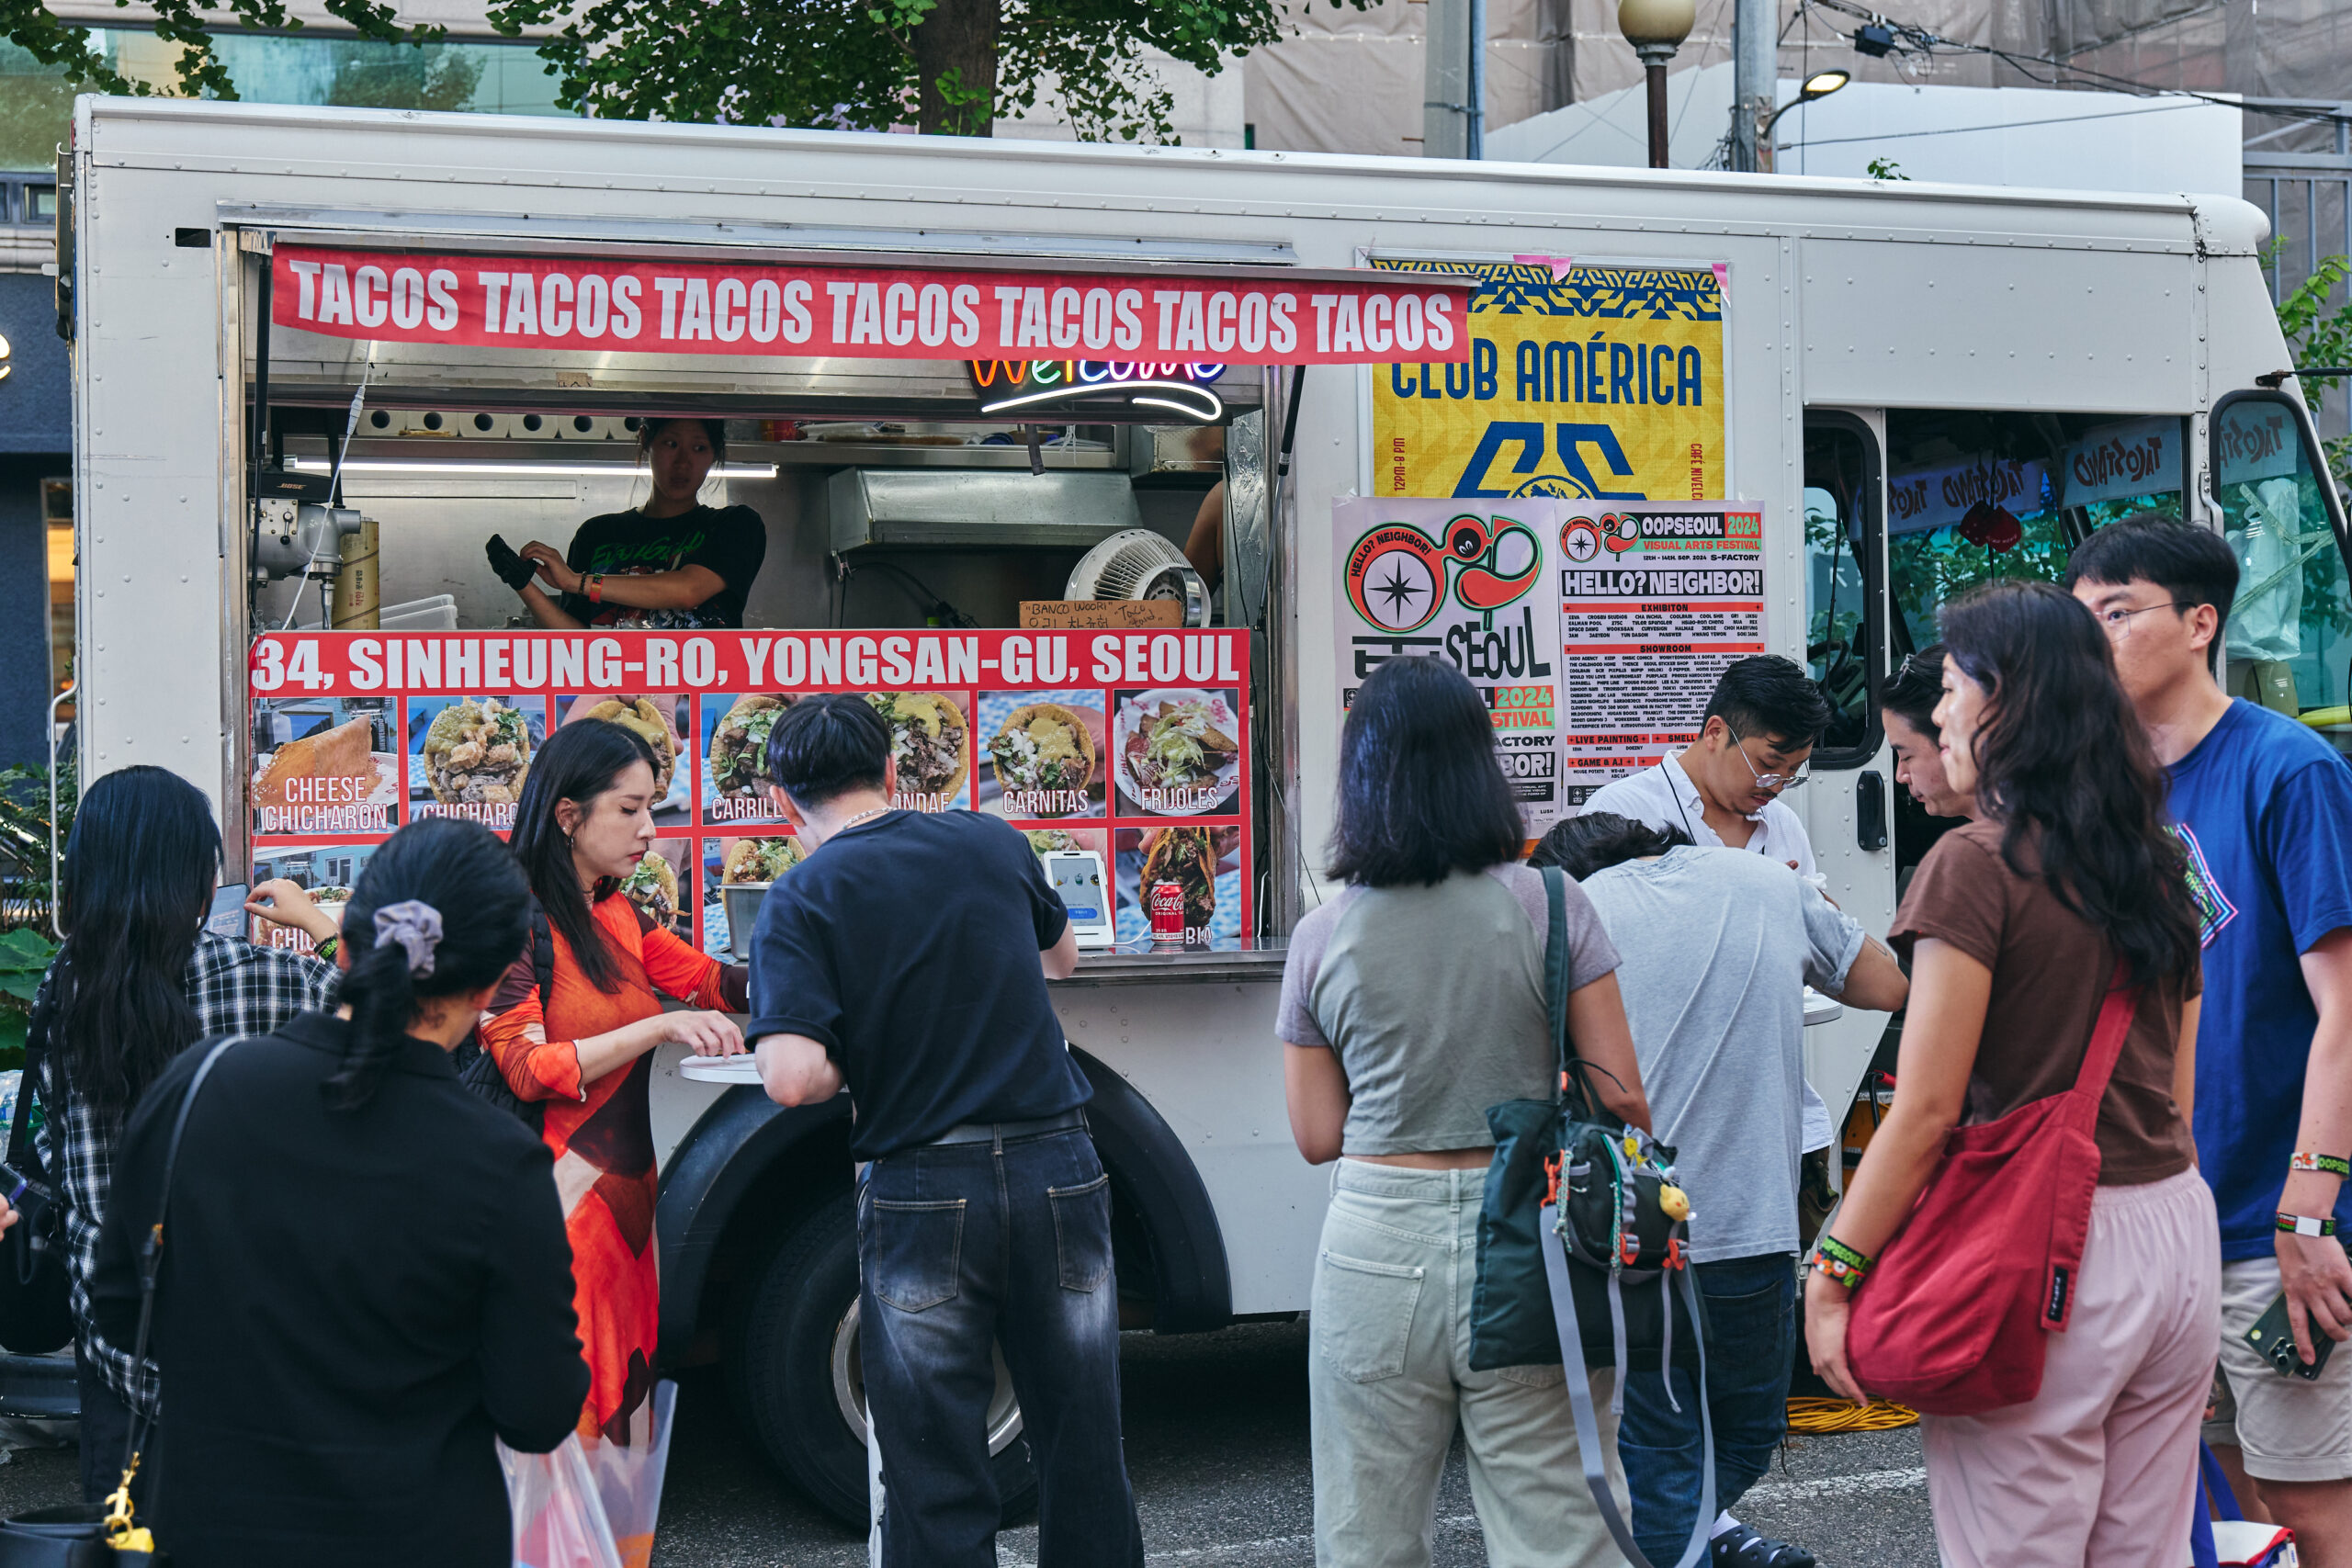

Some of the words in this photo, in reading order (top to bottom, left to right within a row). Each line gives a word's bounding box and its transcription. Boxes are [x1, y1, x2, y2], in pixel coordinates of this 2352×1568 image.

[288, 259, 459, 332] TACOS
[478, 271, 642, 339] TACOS
[654, 276, 813, 344] TACOS
[826, 281, 980, 348] TACOS
[994, 286, 1143, 351] TACOS
[1154, 289, 1297, 354] TACOS
[1311, 292, 1454, 353] TACOS
[1392, 338, 1498, 400] CLUB
[1517, 332, 1702, 406] AMÉRICA
[1393, 437, 1406, 454] PM
[1690, 443, 1705, 465] CAFÉ
[1690, 468, 1703, 501] NIVELC
[1642, 516, 1723, 536] OOPSEOUL
[1727, 515, 1759, 535] 2024
[1351, 539, 1376, 578] HELLO?
[1376, 531, 1432, 557] NEIGHBOR!
[1644, 540, 1681, 550] VISUAL
[1684, 540, 1713, 549] ARTS
[1716, 539, 1760, 550] FESTIVAL
[1565, 570, 1647, 595] HELLO?
[1650, 570, 1760, 594] NEIGHBOR!
[1641, 604, 1689, 613] EXHIBITON
[1640, 645, 1691, 653] SHOWROOM
[252, 638, 334, 691] 34,
[349, 637, 729, 691] SINHEUNG-RO,
[739, 635, 1080, 685] YONGSAN-GU,
[1092, 634, 1239, 682] SEOUL
[1496, 687, 1552, 707] 2024
[1491, 710, 1553, 728] STIVAL
[1495, 736, 1555, 748] ACTORY
[1576, 736, 1594, 744] LIVE
[1598, 735, 1639, 743] PAINTING
[1668, 734, 1696, 742] SMELL
[1577, 759, 1601, 767] GAME
[285, 776, 368, 803] CHEESE
[1141, 786, 1219, 811] FRIJOLES
[712, 797, 788, 820] CARRILL
[1003, 789, 1090, 813] CARNITAS
[264, 804, 388, 831] CHICHARON
[423, 802, 519, 827] CHICHARO
[1151, 892, 1184, 911] Coca-Co
